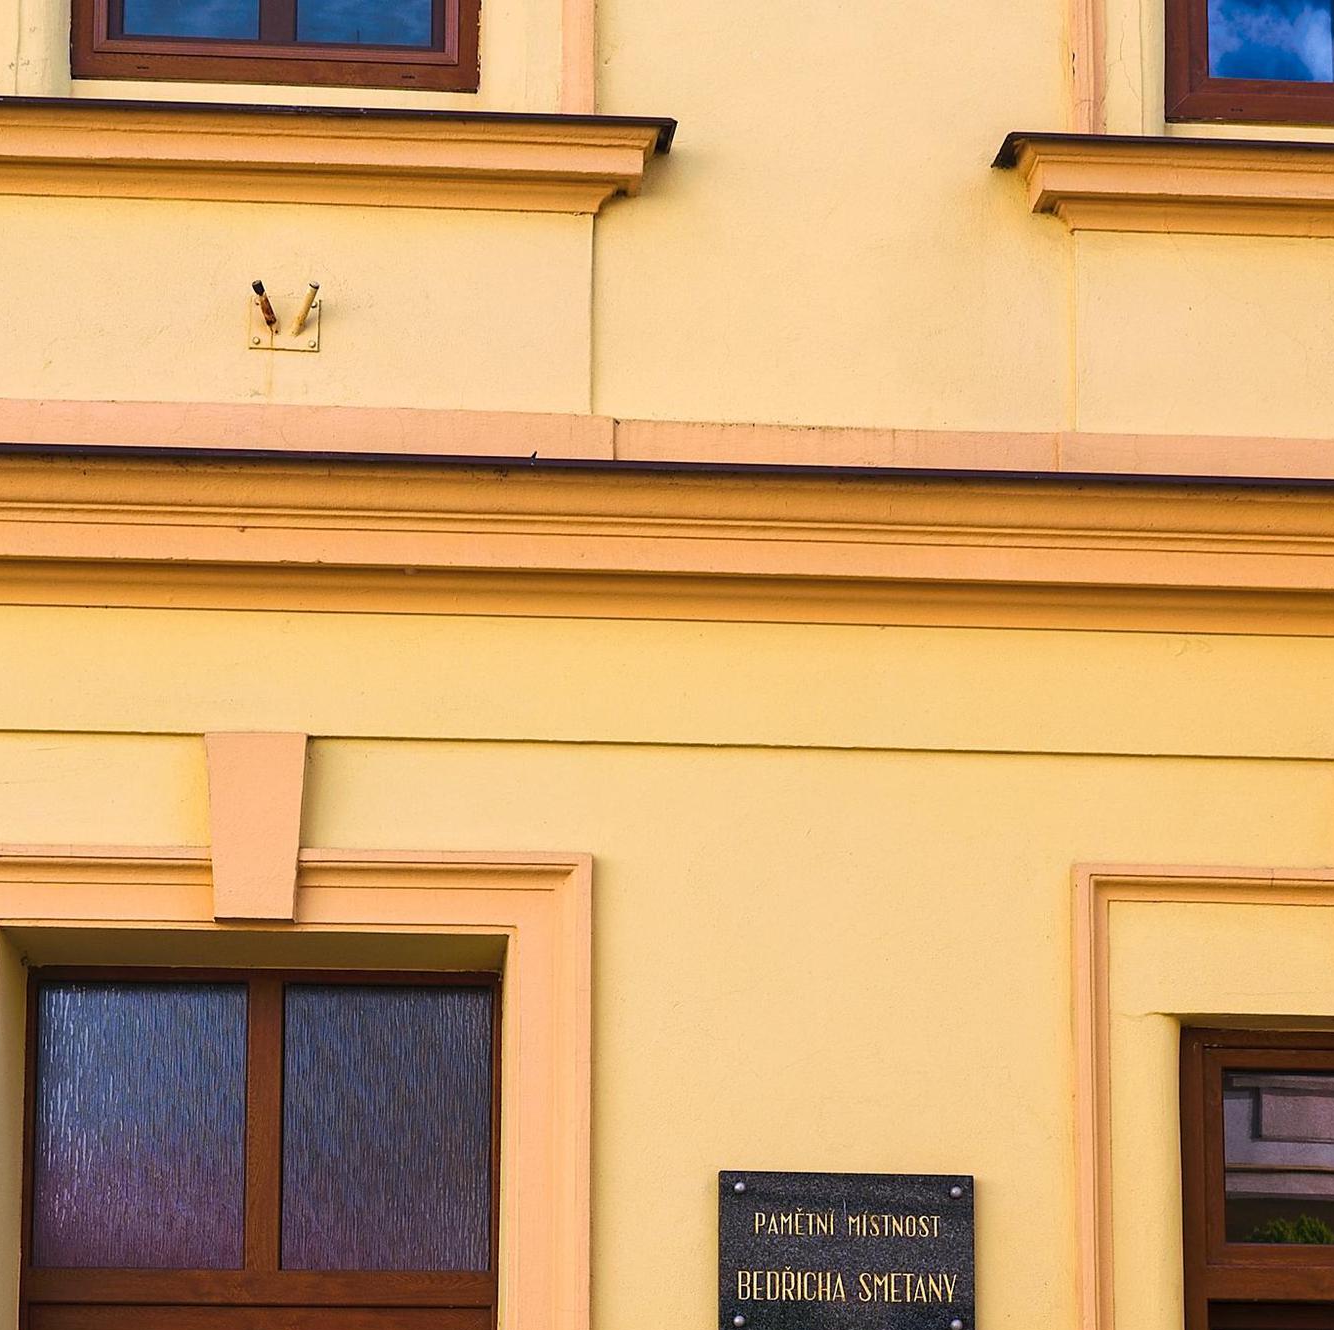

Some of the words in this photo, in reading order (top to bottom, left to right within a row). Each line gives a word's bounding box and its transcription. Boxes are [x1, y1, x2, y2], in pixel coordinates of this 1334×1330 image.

[753, 1207, 835, 1236] PAMĚTNÍ
[847, 1210, 941, 1238] MÍSTNOST
[736, 1265, 847, 1302] BEDŘICHA
[858, 1271, 958, 1304] SMETANY
